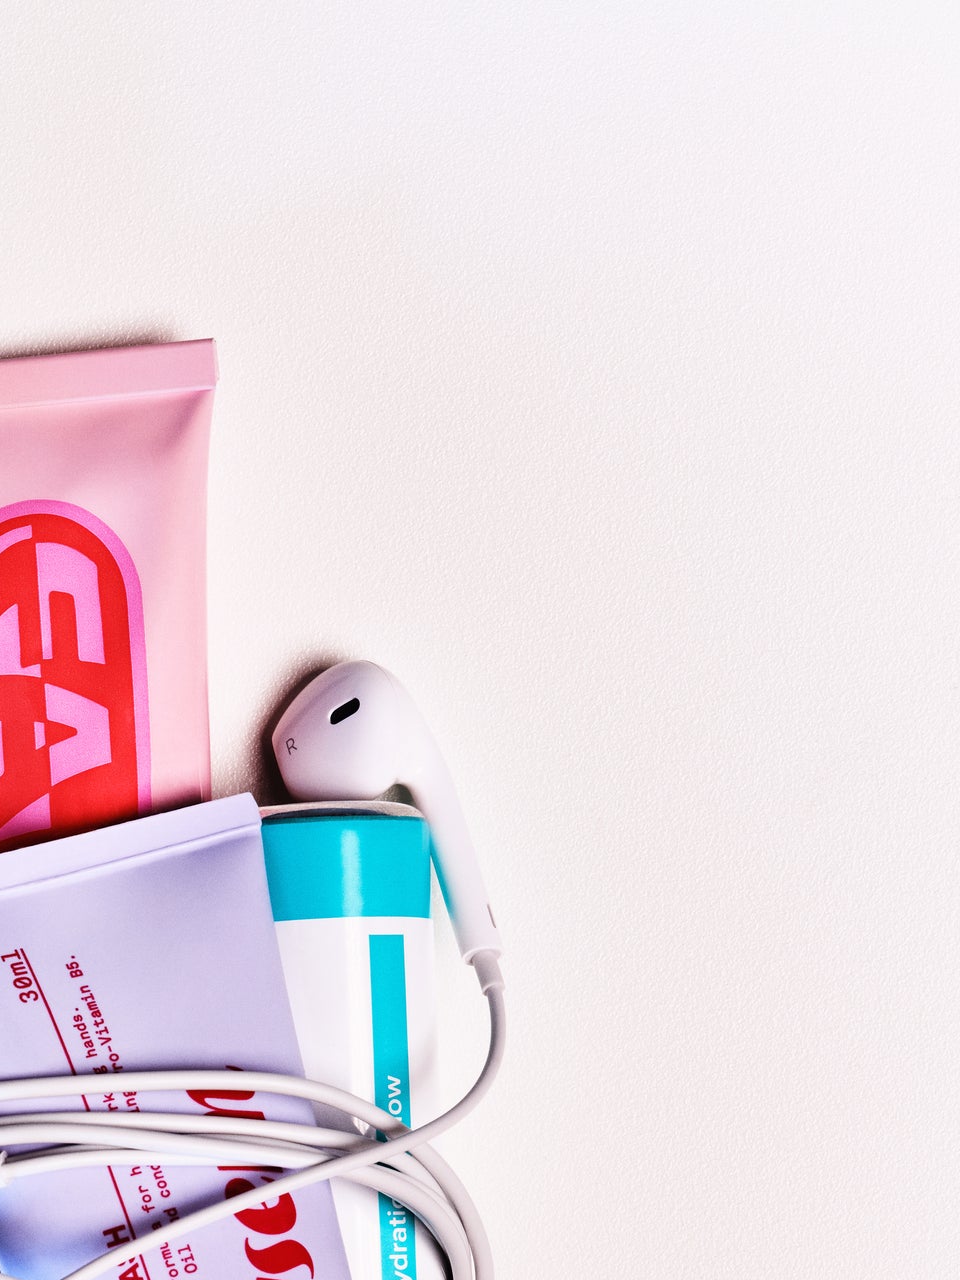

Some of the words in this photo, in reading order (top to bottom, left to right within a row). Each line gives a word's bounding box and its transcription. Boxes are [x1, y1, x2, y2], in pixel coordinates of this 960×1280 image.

[285, 737, 298, 755] R
[0, 948, 39, 1004] 30ml
[65, 954, 84, 979] B5.
[72, 1007, 98, 1059] hands.
[79, 984, 124, 1073] ro-Vitamin
[138, 1185, 156, 1214] for
[176, 1243, 198, 1274] Oil
